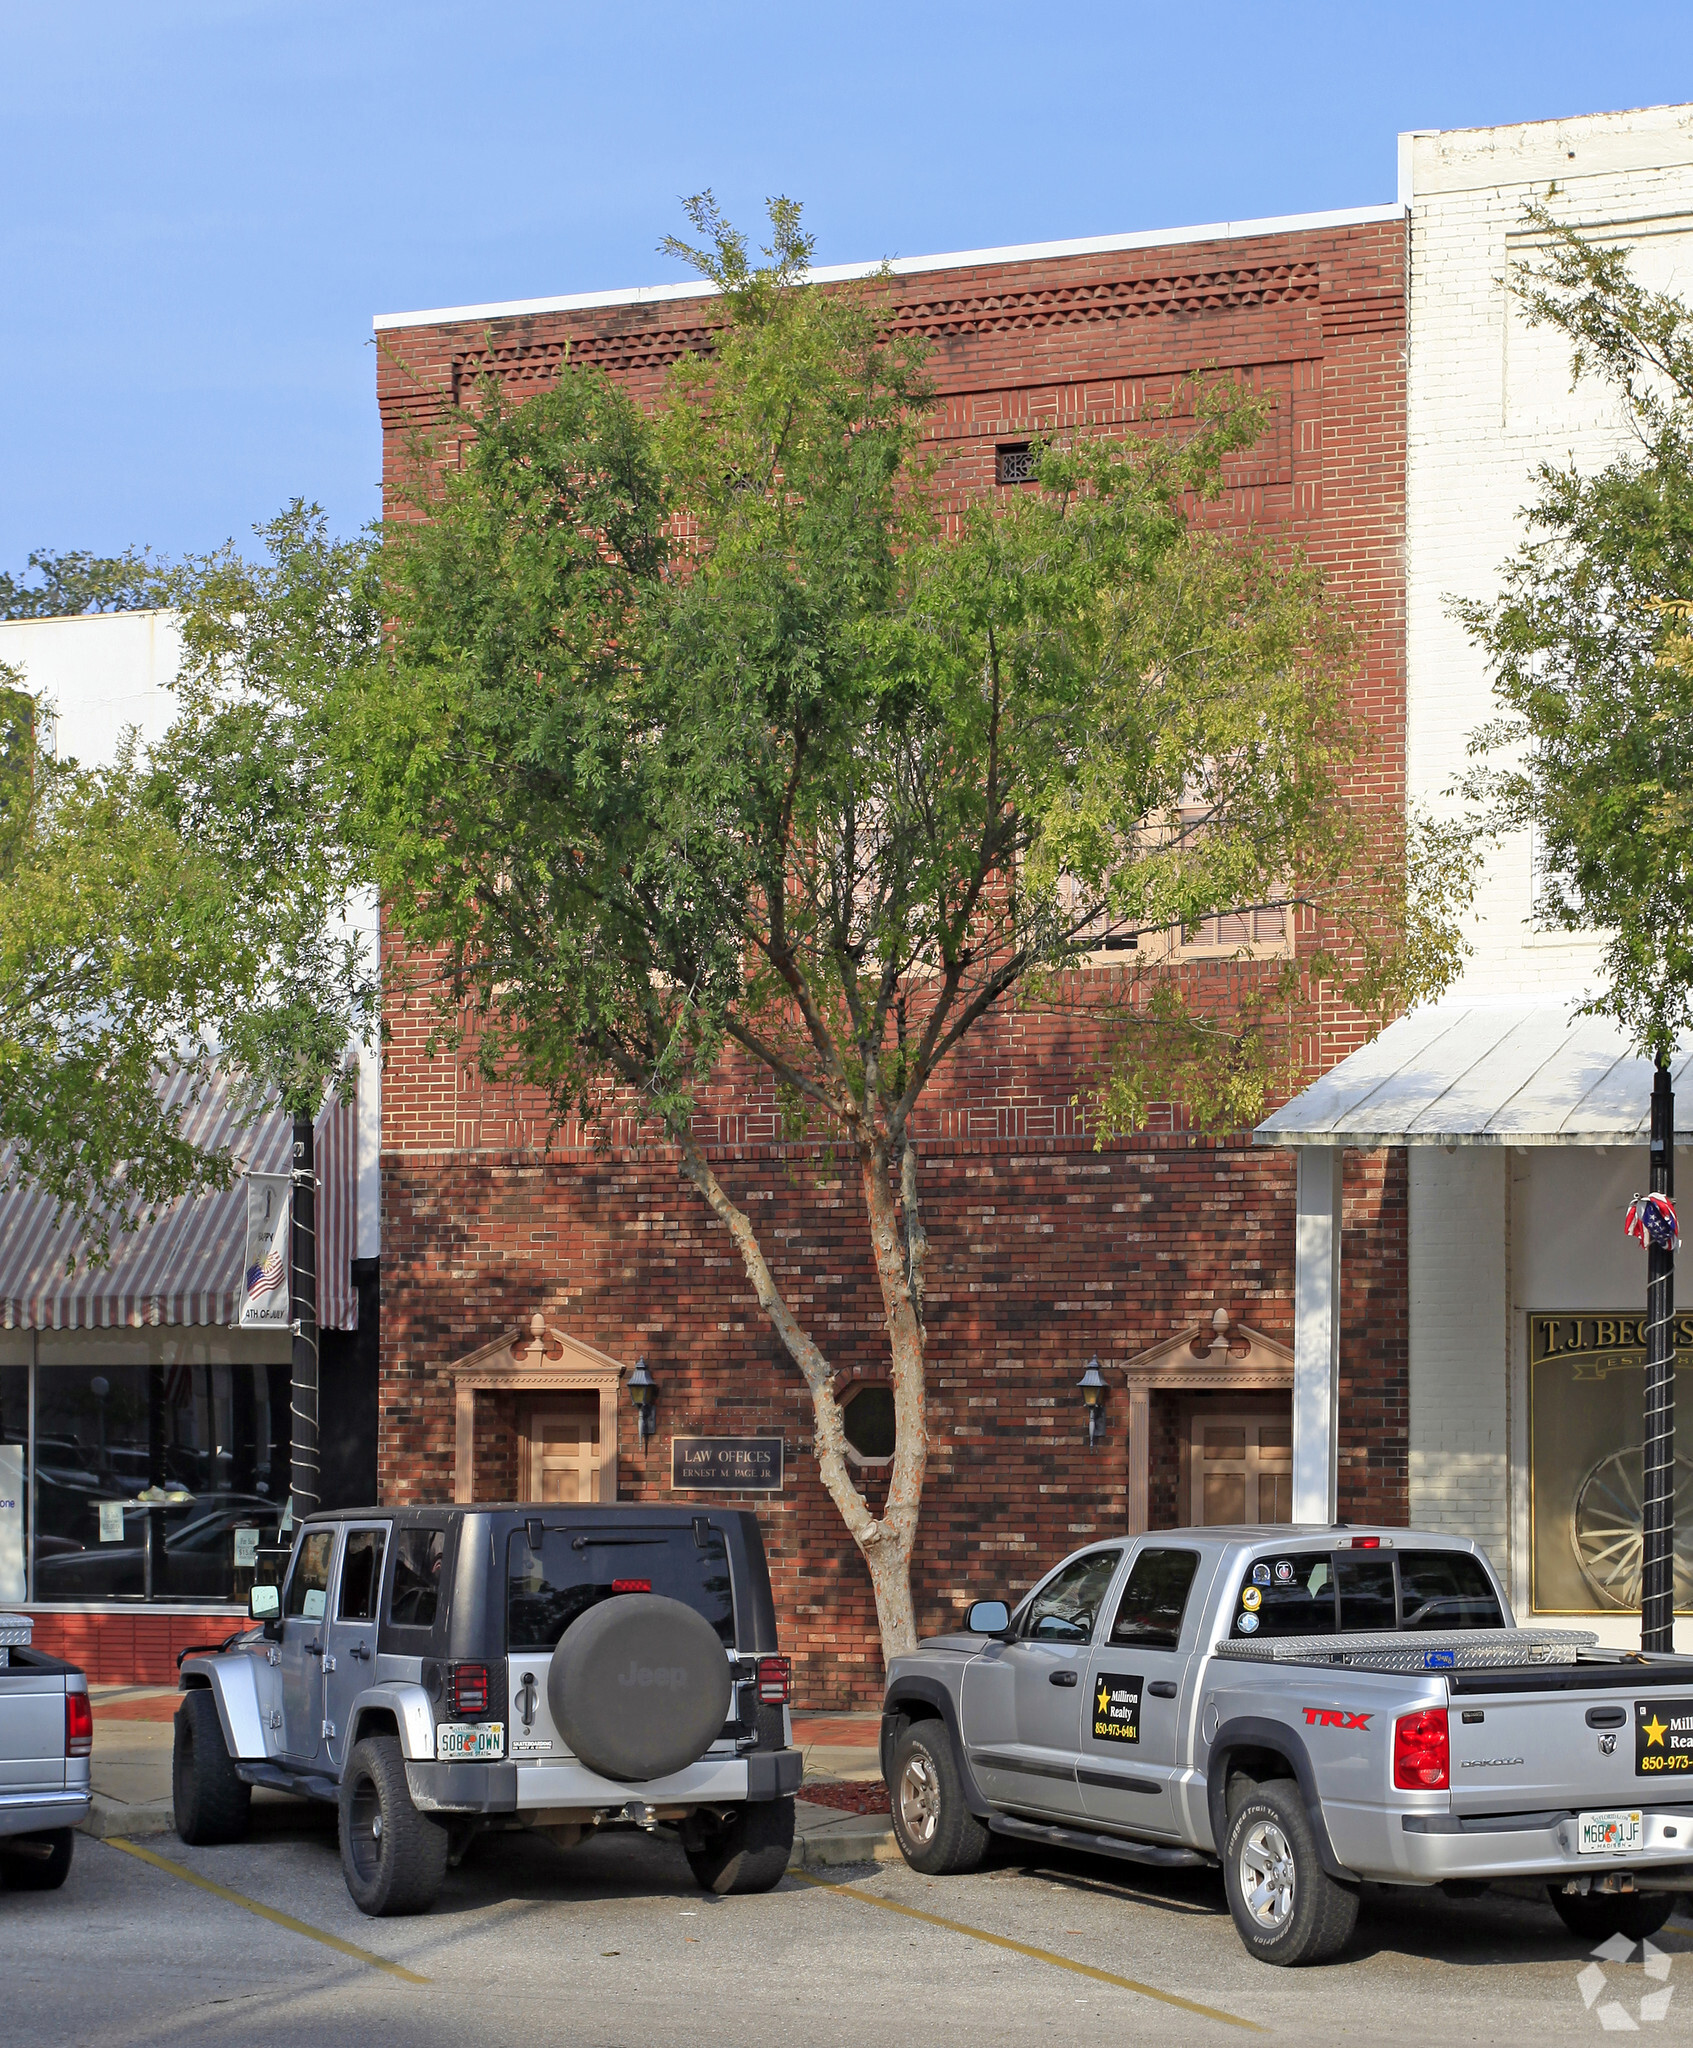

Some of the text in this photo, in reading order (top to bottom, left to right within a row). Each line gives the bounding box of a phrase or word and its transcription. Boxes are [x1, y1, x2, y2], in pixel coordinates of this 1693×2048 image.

[260, 1309, 270, 1318] OF
[684, 1450, 771, 1463] LAW OFFICES
[682, 1468, 716, 1477] ERNEST
[734, 1469, 758, 1478] PAGE
[618, 1661, 688, 1691] Jeep
[1111, 1690, 1138, 1704] Milliron
[1110, 1706, 1132, 1721] Realty
[1302, 1707, 1375, 1731] TRX
[1670, 1717, 1693, 1731] Mill
[1670, 1735, 1693, 1749] Rea
[1461, 1758, 1524, 1768] DAKOTA
[1584, 1823, 1639, 1843] M68 1JF
